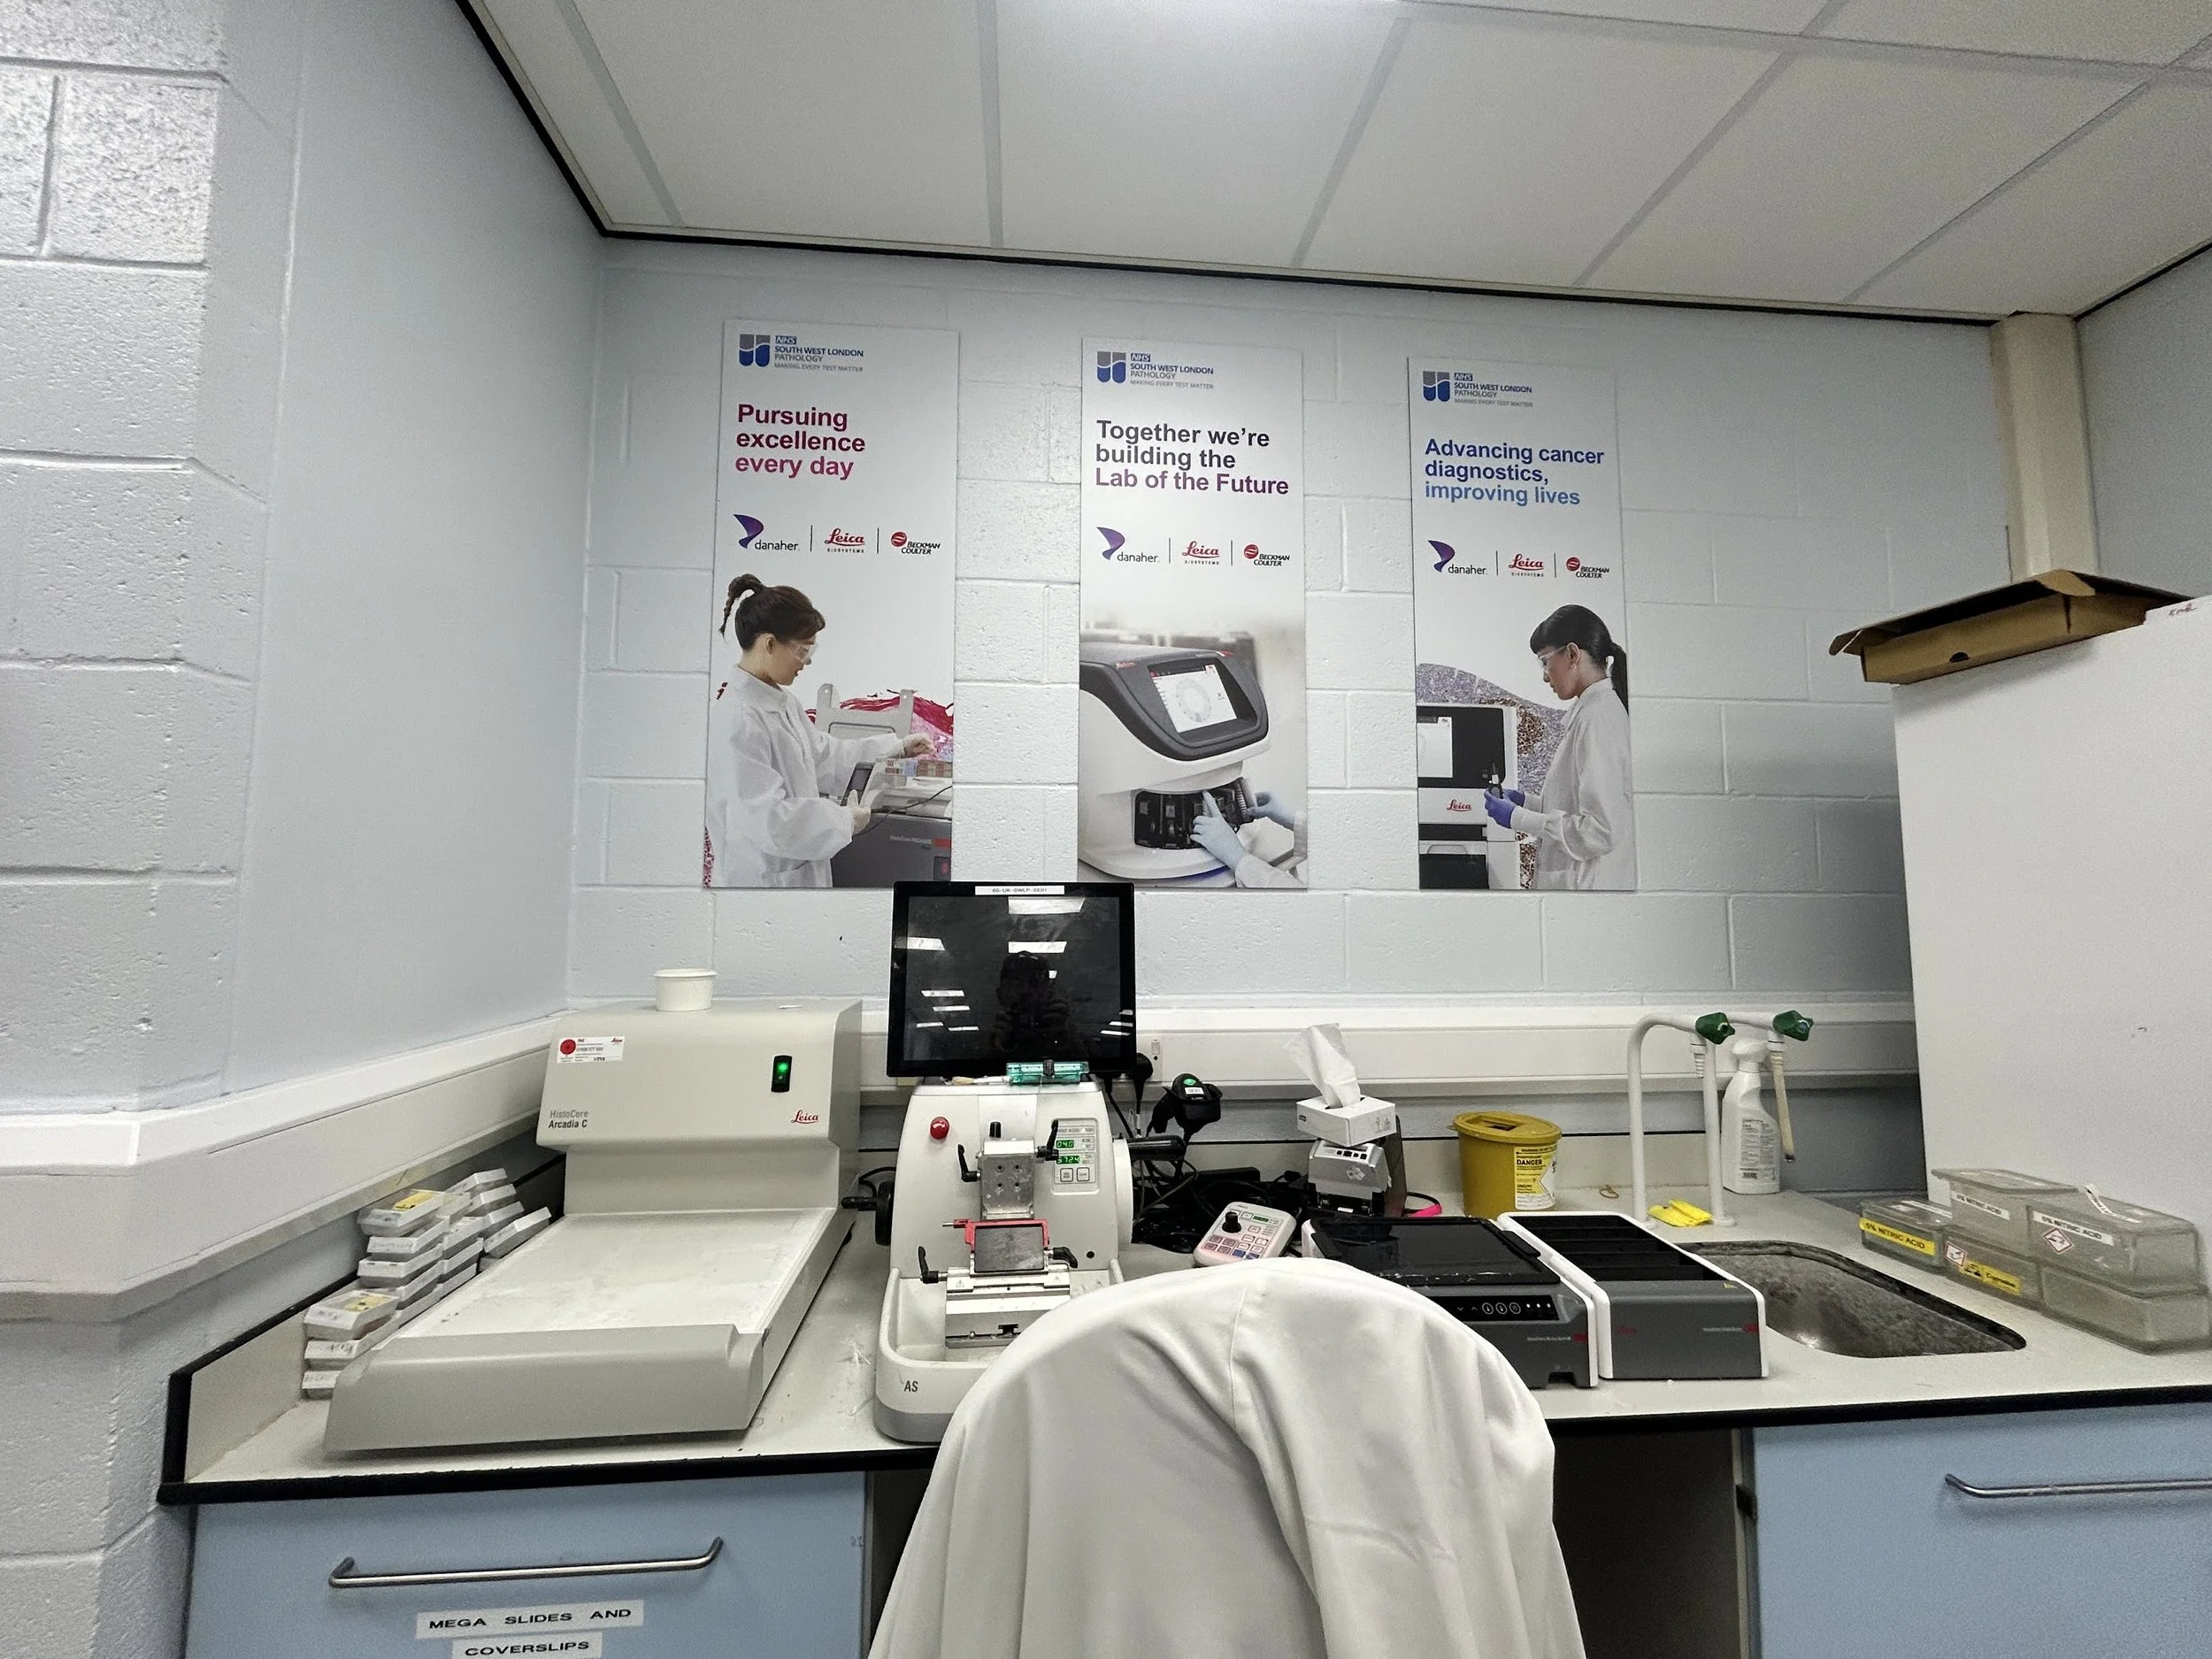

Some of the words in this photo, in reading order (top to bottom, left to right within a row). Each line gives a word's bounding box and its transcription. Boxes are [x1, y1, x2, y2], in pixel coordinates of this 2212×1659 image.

[775, 354, 823, 363] PATHOLOGY
[1131, 353, 1150, 362] NHS
[1130, 371, 1176, 380] PATHOLOGY
[1454, 389, 1497, 398] PATHOLOGY
[737, 403, 848, 432] Pursuing
[1096, 419, 1201, 444] Together
[736, 430, 865, 452] excellence
[1095, 443, 1192, 471] building
[1199, 449, 1236, 468] the
[1425, 438, 1532, 464] Advancing
[1539, 449, 1604, 464] cancer
[734, 457, 803, 479] every
[810, 456, 854, 480] day
[1425, 460, 1548, 485] diagnostics,
[1095, 467, 1138, 488] Lab
[1145, 471, 1168, 489] of
[1173, 472, 1209, 491] the
[1217, 473, 1289, 495] Future
[1425, 481, 1528, 506] improving
[1535, 487, 1580, 505] lives
[825, 528, 865, 547] Leica
[907, 541, 941, 549] BECKMAN
[1182, 541, 1221, 559] Leica
[1509, 554, 1545, 572] Leica
[1447, 800, 1472, 812] Leica
[549, 1110, 589, 1118] HistoCore
[791, 1110, 819, 1125] Leica
[548, 1119, 580, 1129] Arcadia
[581, 1118, 588, 1128] C
[1878, 1226, 1904, 1241] NITRIC
[1905, 1237, 1925, 1249] ACID
[2082, 1228, 2103, 1240] ACID
[904, 1380, 918, 1393] AS
[429, 1618, 487, 1629] MEGA
[504, 1613, 573, 1624] SLIDES
[589, 1609, 632, 1620] AND
[465, 1641, 589, 1656] COVERSLIPS
